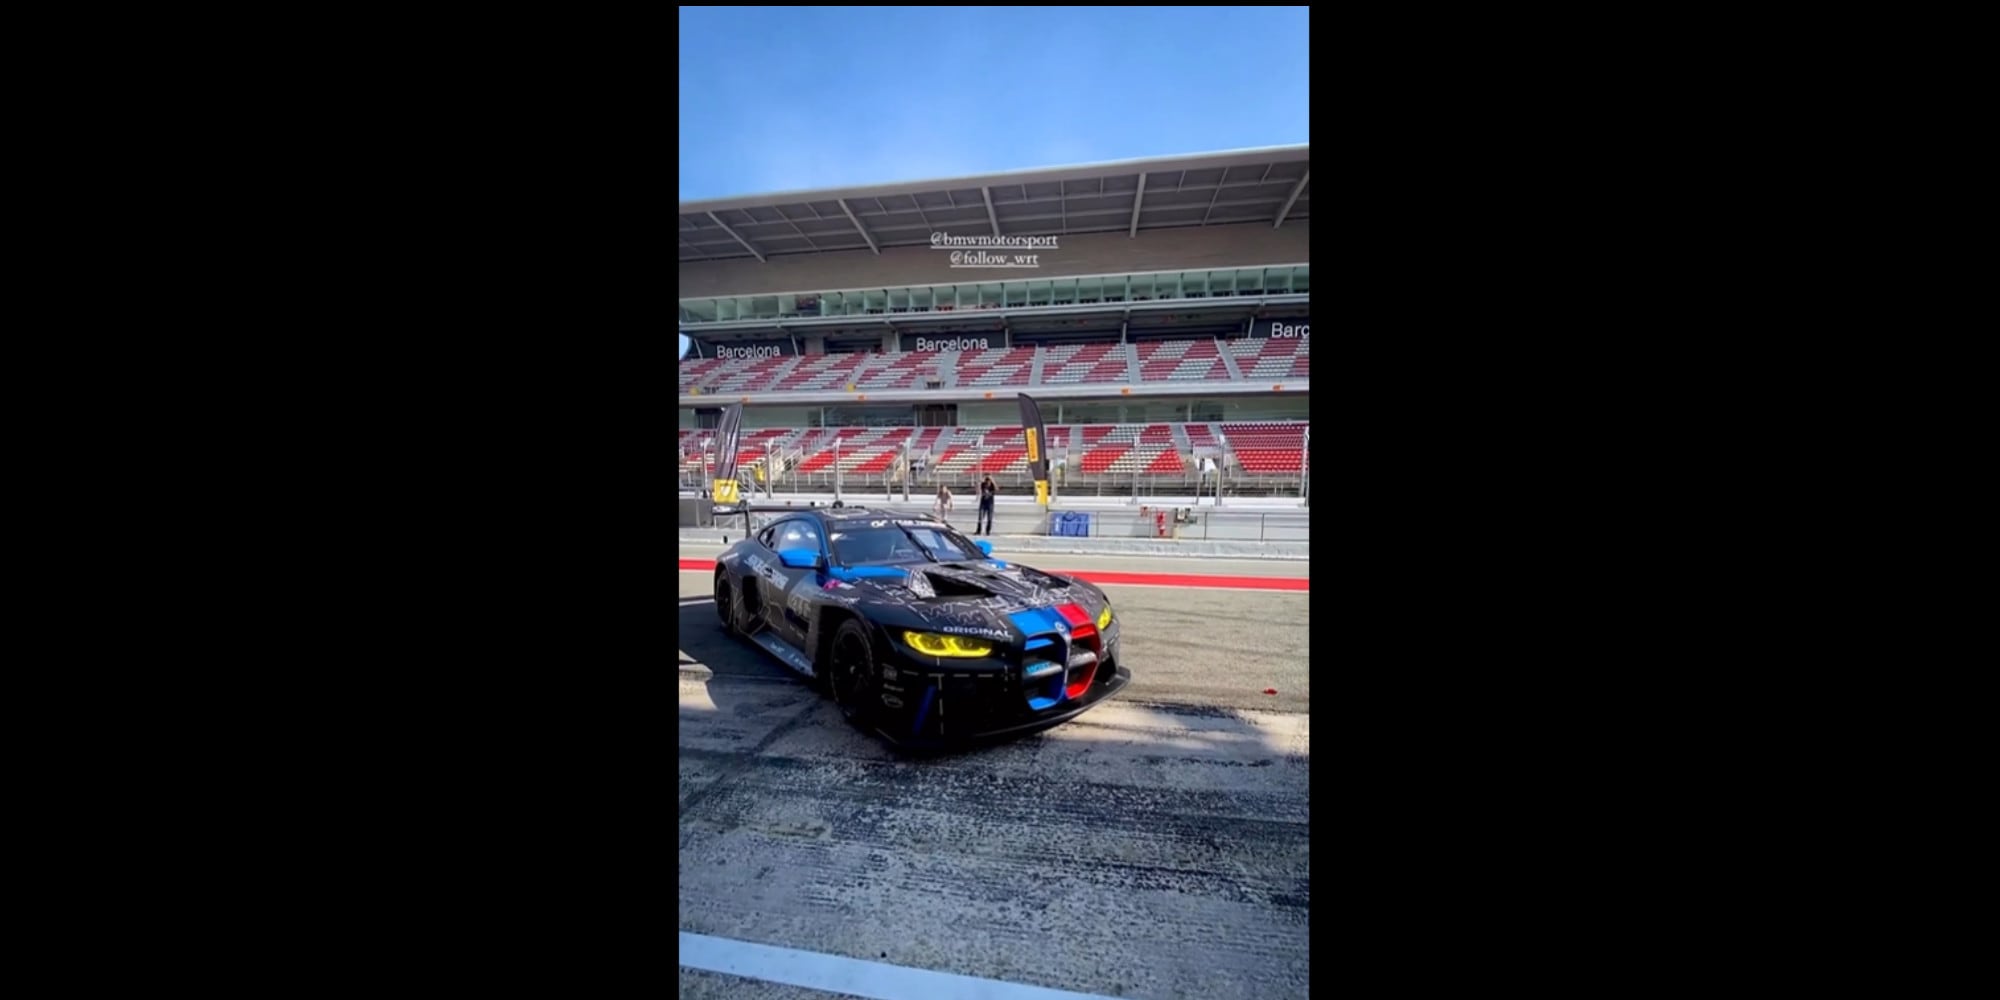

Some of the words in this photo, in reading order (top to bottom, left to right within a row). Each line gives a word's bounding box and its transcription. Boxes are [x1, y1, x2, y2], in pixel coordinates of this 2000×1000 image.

[716, 344, 781, 359] Barcelona
[915, 336, 989, 352] Barcelona
[943, 625, 1011, 638] ORIGINAL
